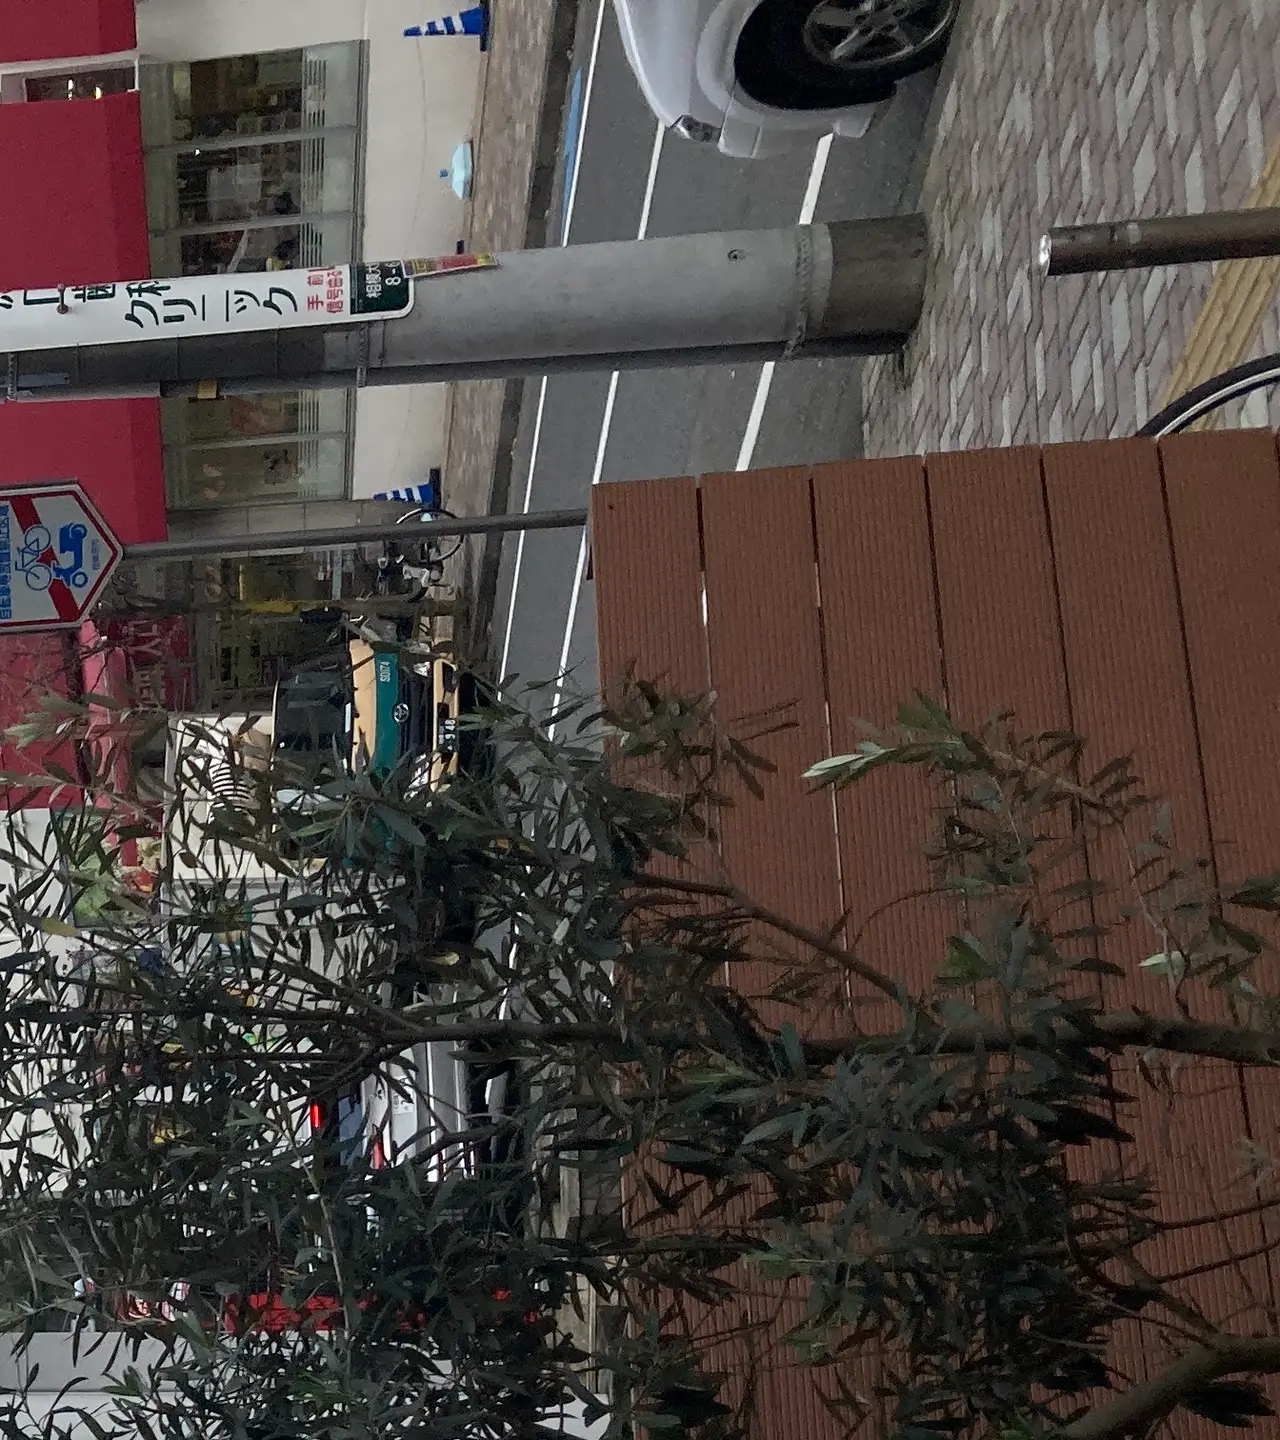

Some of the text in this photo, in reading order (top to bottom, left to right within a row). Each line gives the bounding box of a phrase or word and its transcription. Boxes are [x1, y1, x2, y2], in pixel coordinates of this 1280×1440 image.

[124, 286, 298, 329] クリニック
